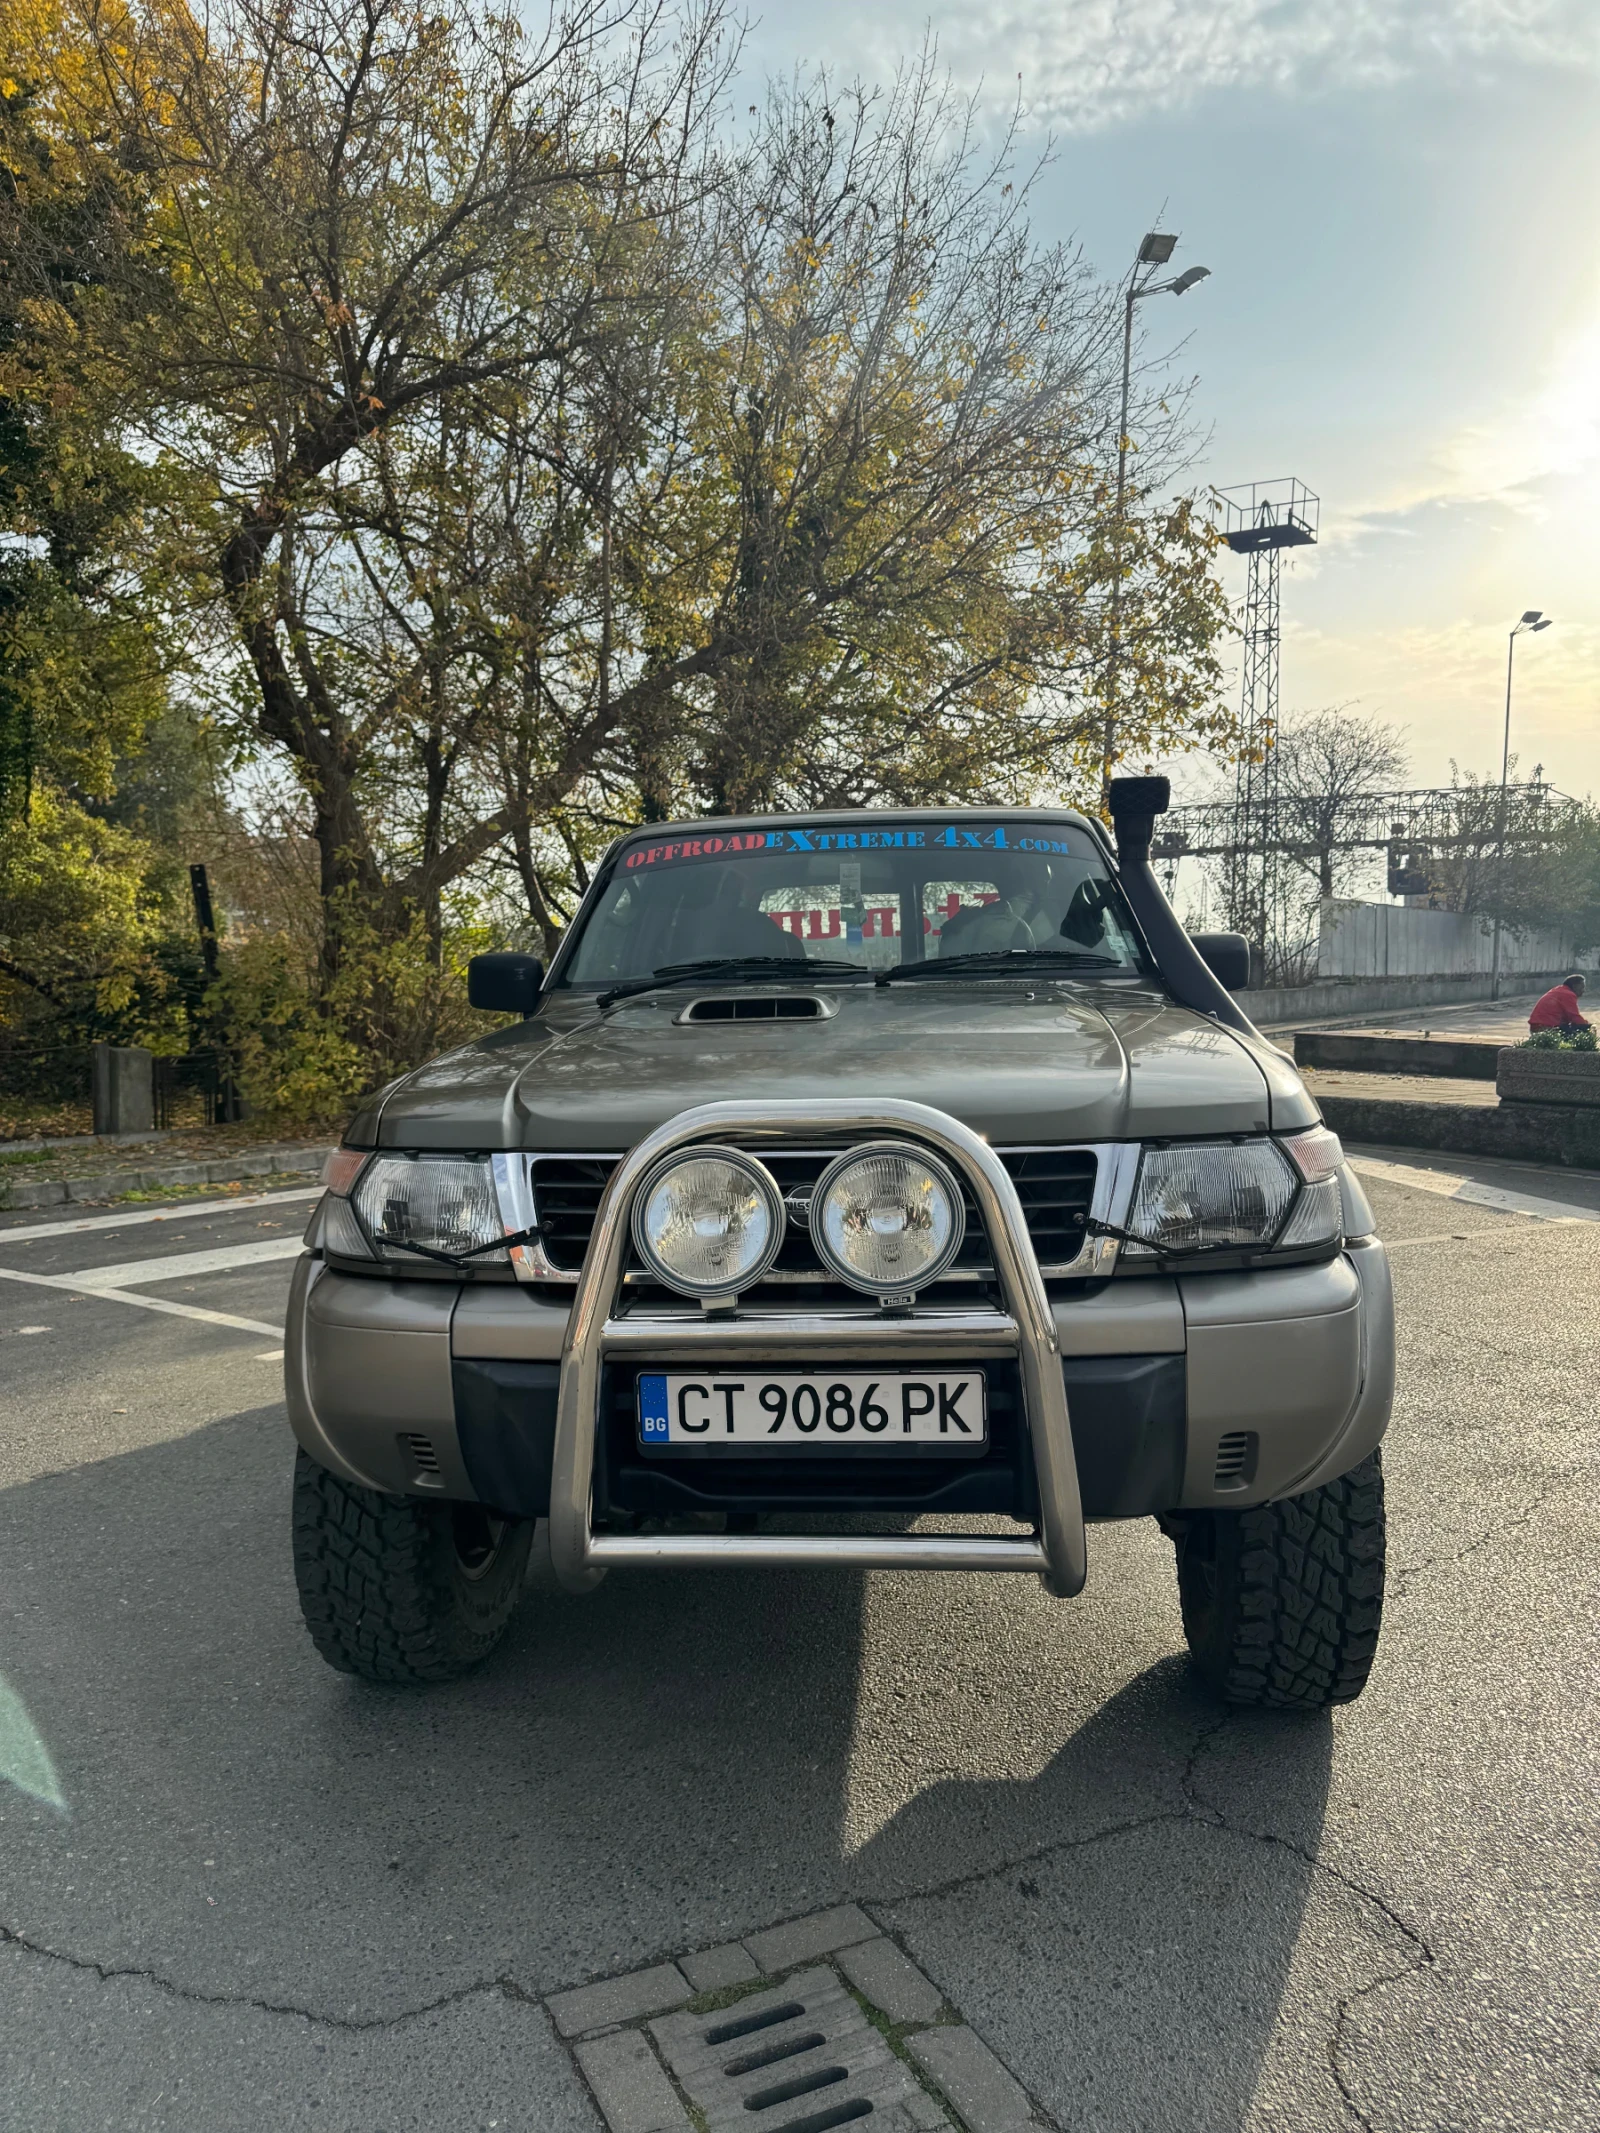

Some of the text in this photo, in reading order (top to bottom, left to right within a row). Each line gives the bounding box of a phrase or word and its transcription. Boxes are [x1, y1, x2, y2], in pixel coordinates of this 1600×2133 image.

[644, 1382, 972, 1433] BG CT 9086 PK
